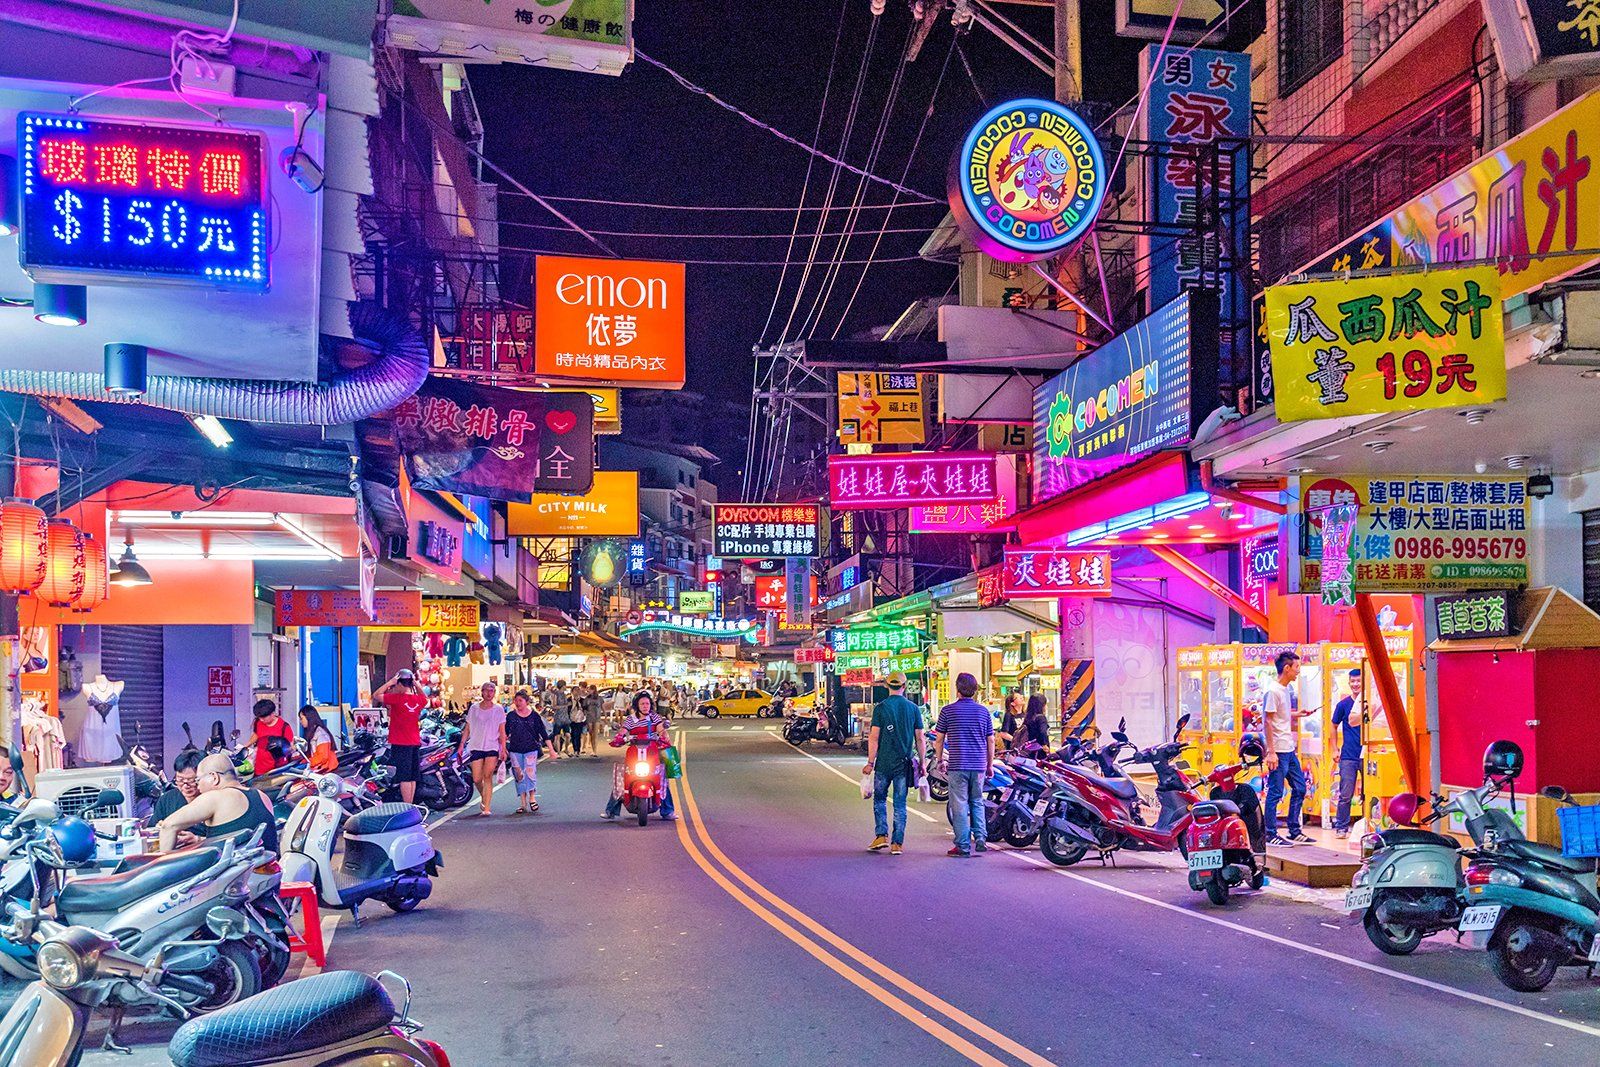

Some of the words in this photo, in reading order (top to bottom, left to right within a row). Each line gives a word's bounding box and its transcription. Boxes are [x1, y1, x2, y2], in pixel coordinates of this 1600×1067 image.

[986, 204, 1080, 240] COCOMEN
[555, 273, 668, 310] emon
[586, 313, 638, 347] 依夢
[555, 352, 667, 371] 時尚精品內衣
[1376, 349, 1478, 400] 19元
[1074, 359, 1159, 433] COCOMEN
[1369, 481, 1525, 505] 逢甲店面/整棟套房
[538, 501, 570, 514] CITY
[574, 501, 608, 514] MILK
[717, 507, 780, 522] JOYROOM
[781, 507, 816, 522] 機樂堂
[1369, 507, 1526, 531] 大樓/大型店面出租
[717, 524, 752, 538] 3C配件
[720, 541, 770, 553] iPhone
[1394, 536, 1527, 560] 0986-995679
[422, 603, 477, 627] 刀削麵
[1438, 596, 1506, 635] 青草苦茶
[847, 629, 915, 651] 阿宗青草茶
[1190, 855, 1222, 867] 371-TAZ
